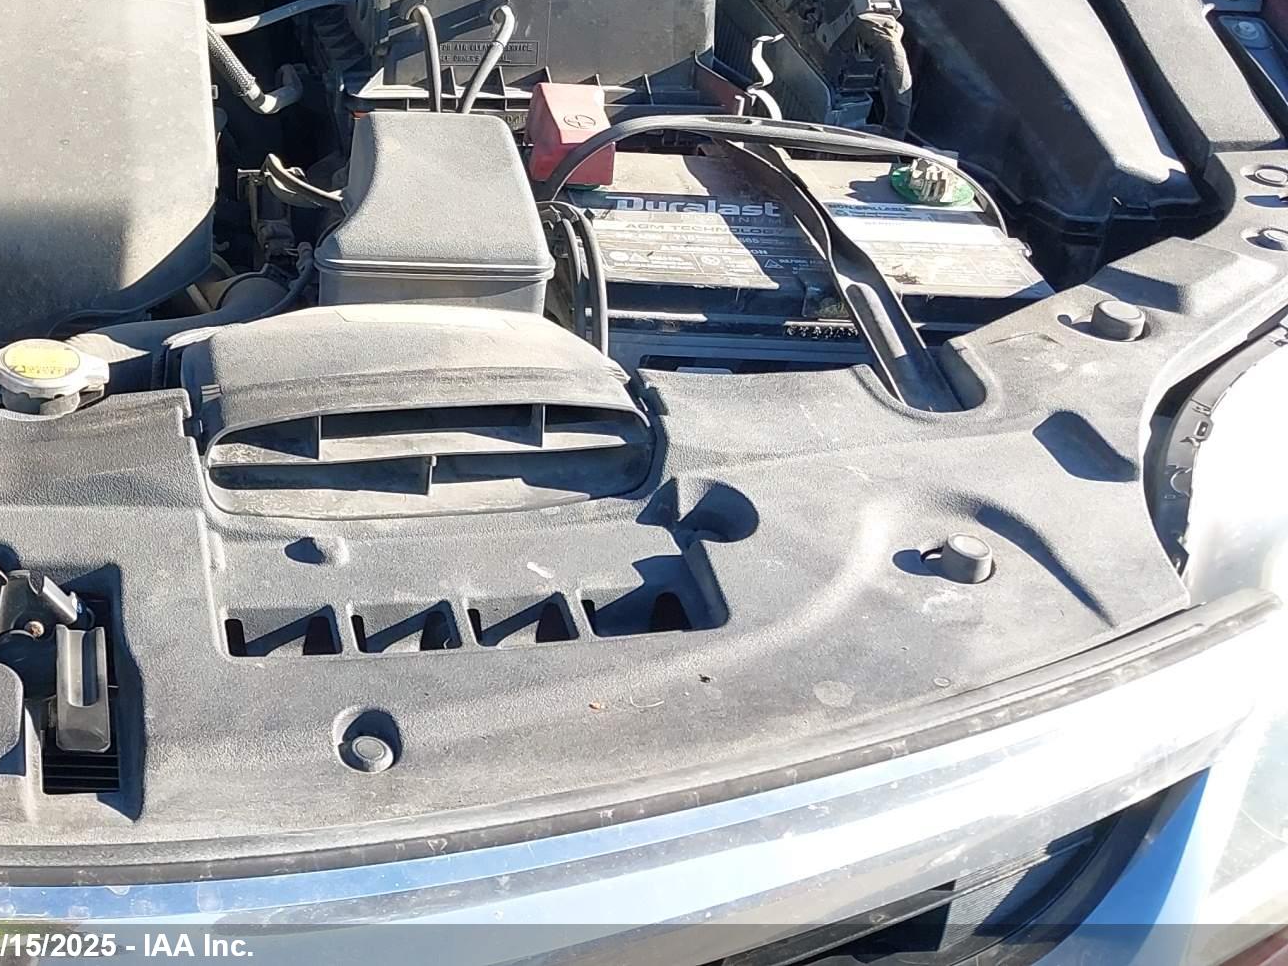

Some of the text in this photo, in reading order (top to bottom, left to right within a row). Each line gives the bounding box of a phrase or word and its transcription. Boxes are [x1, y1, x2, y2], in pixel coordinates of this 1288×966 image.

[605, 195, 781, 218] Duralast
[626, 222, 784, 234] AGM TECHNOLOGY
